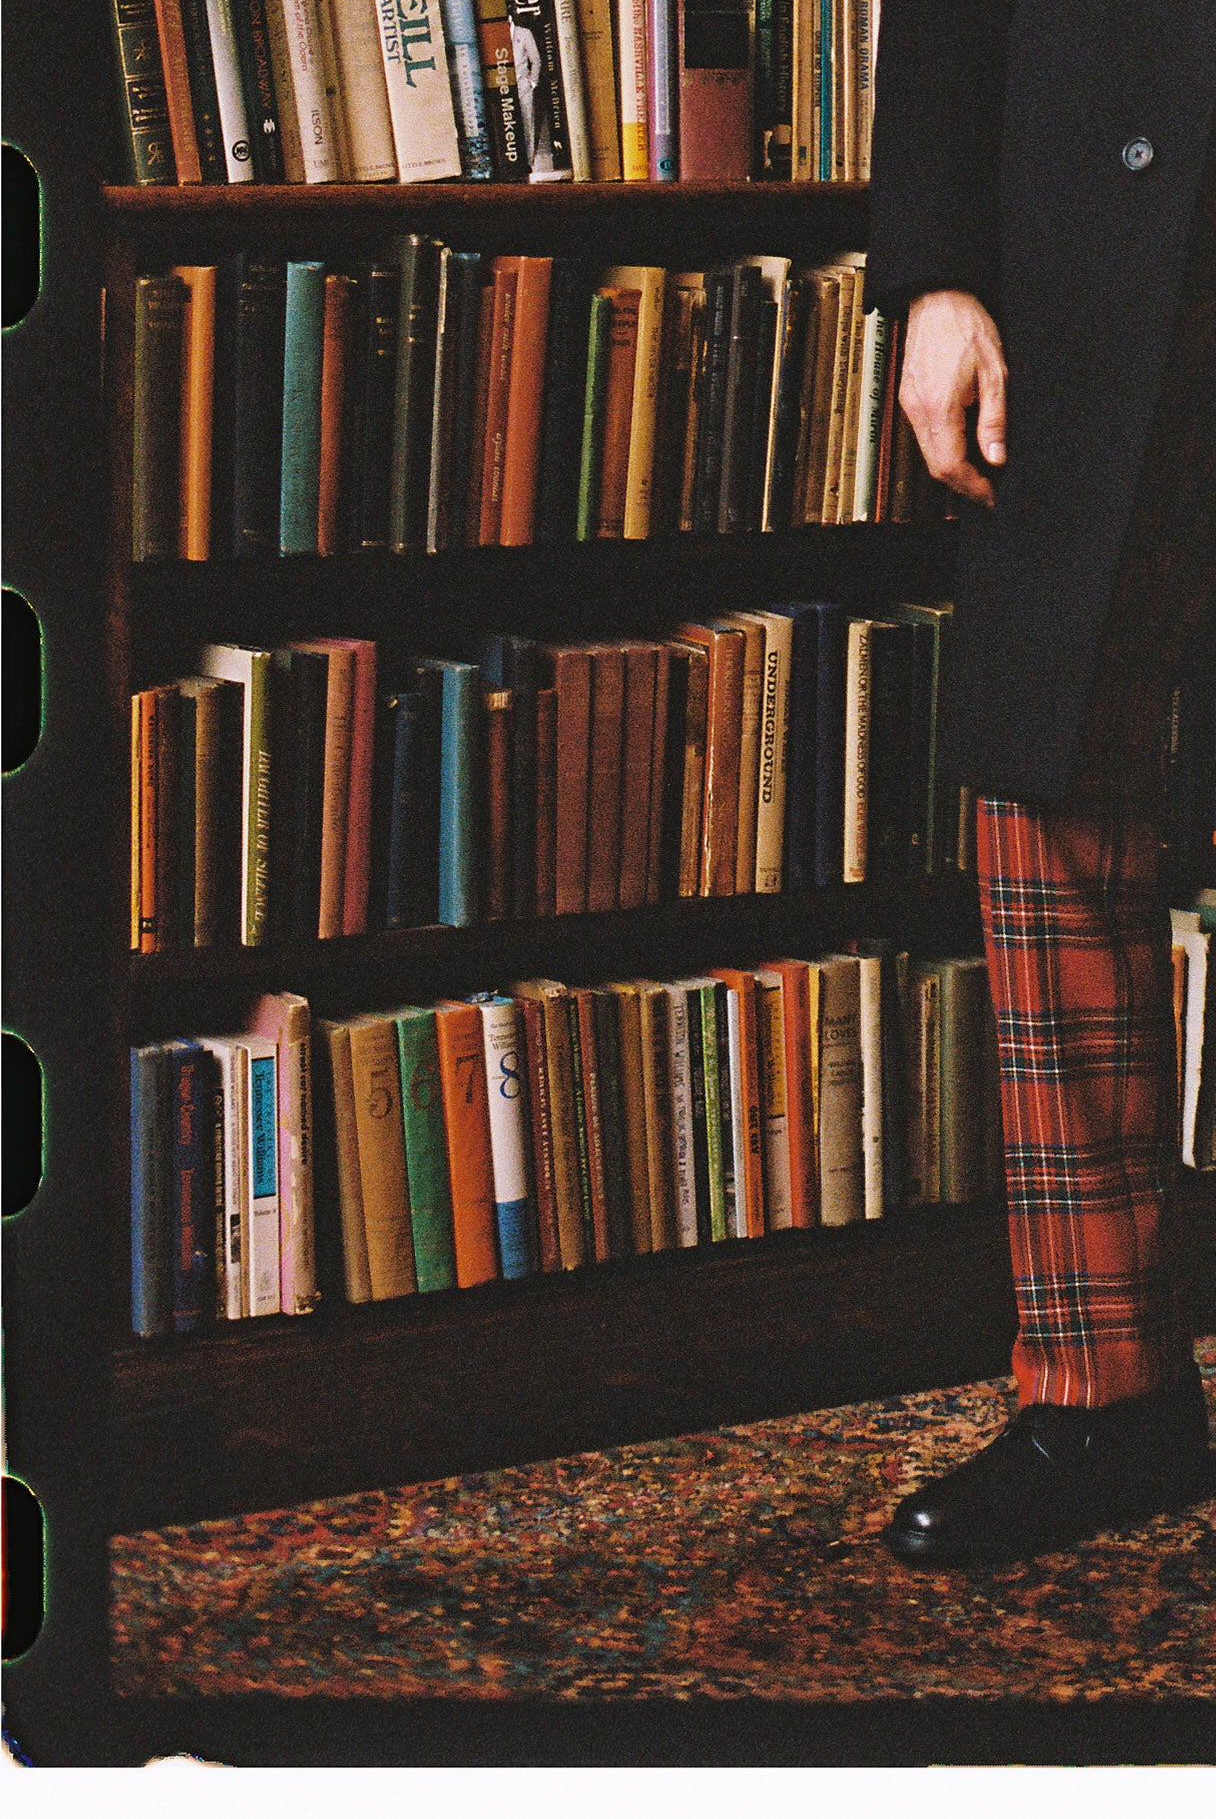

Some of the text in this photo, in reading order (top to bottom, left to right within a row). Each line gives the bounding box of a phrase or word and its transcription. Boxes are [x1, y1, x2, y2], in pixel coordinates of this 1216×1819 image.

[250, 0, 262, 26] ON
[299, 42, 309, 72] Opera
[633, 26, 646, 94] NASHVILLE
[778, 17, 791, 60] English
[859, 1, 869, 91] ROMAN DRAMA
[253, 31, 272, 110] BROADWAY
[543, 22, 563, 130] William McBrien
[777, 62, 790, 113] History
[312, 110, 324, 145] ILSON
[494, 48, 520, 162] Stage Makeup
[871, 342, 884, 382] House
[835, 362, 849, 415] Everything
[869, 387, 881, 400] of
[859, 634, 868, 677] ZALMEN
[858, 693, 867, 712] THE
[762, 650, 779, 804] UNDERGROUND
[857, 715, 867, 760] MADNESS
[857, 775, 866, 798] GOD
[857, 801, 865, 820] ELIE
[369, 1069, 393, 1119] 5
[410, 1060, 437, 1111] 6
[455, 1053, 480, 1104] 7
[500, 1050, 521, 1099] 8
[254, 1070, 267, 1185] Tennessee Williams
[300, 1094, 310, 1130] named
[301, 1133, 309, 1166] desire
